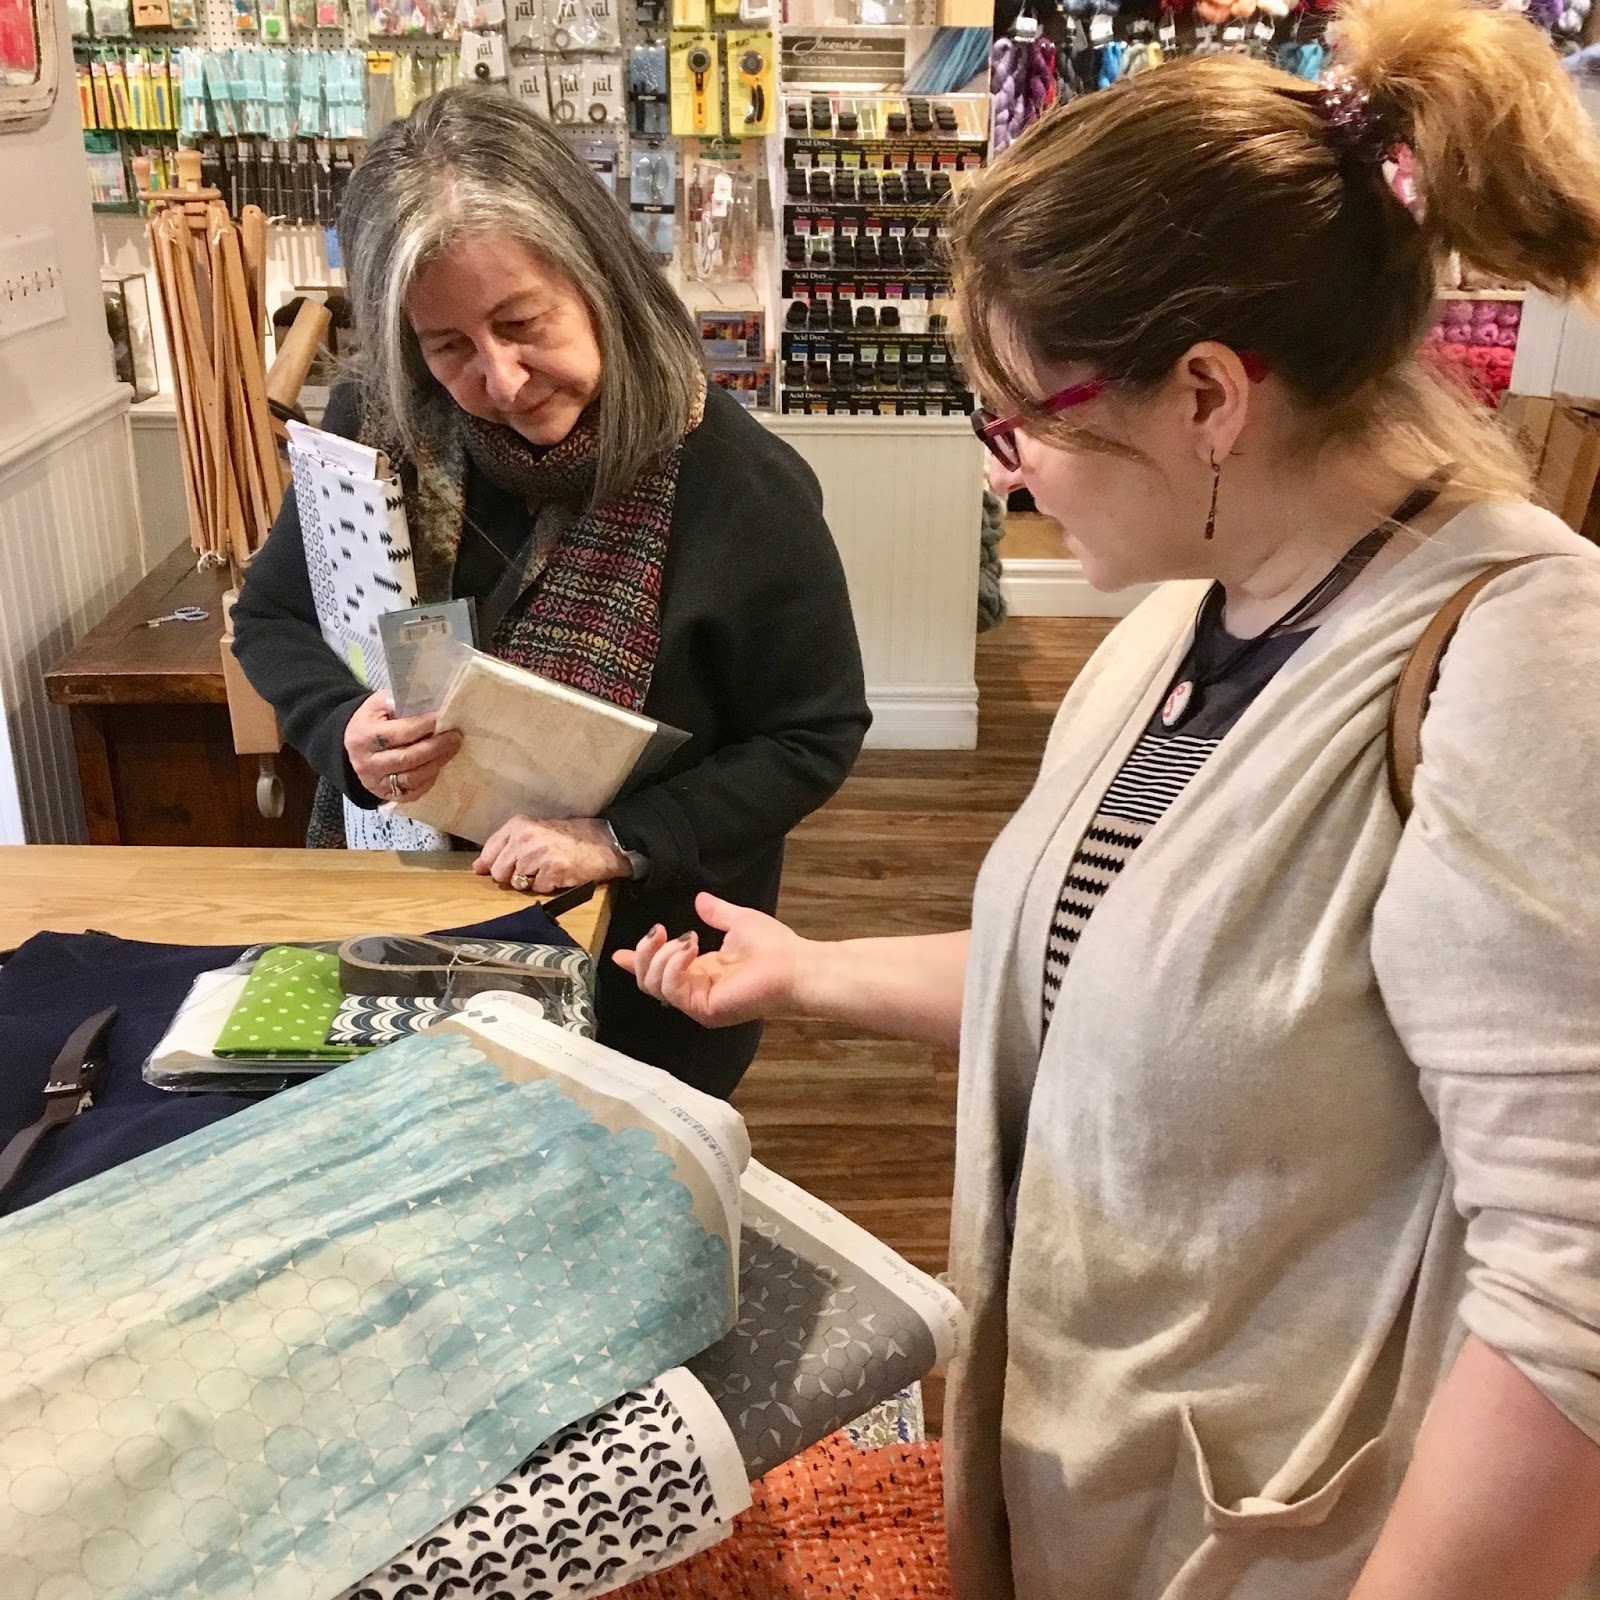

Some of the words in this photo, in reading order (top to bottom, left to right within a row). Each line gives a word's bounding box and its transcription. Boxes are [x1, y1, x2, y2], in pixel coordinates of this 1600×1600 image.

[796, 139, 812, 147] Acid
[813, 139, 830, 149] Dyes
[812, 206, 829, 215] Dyes
[810, 272, 827, 281] Dyes
[809, 334, 826, 343] Dyes
[805, 392, 822, 401] Dyes
